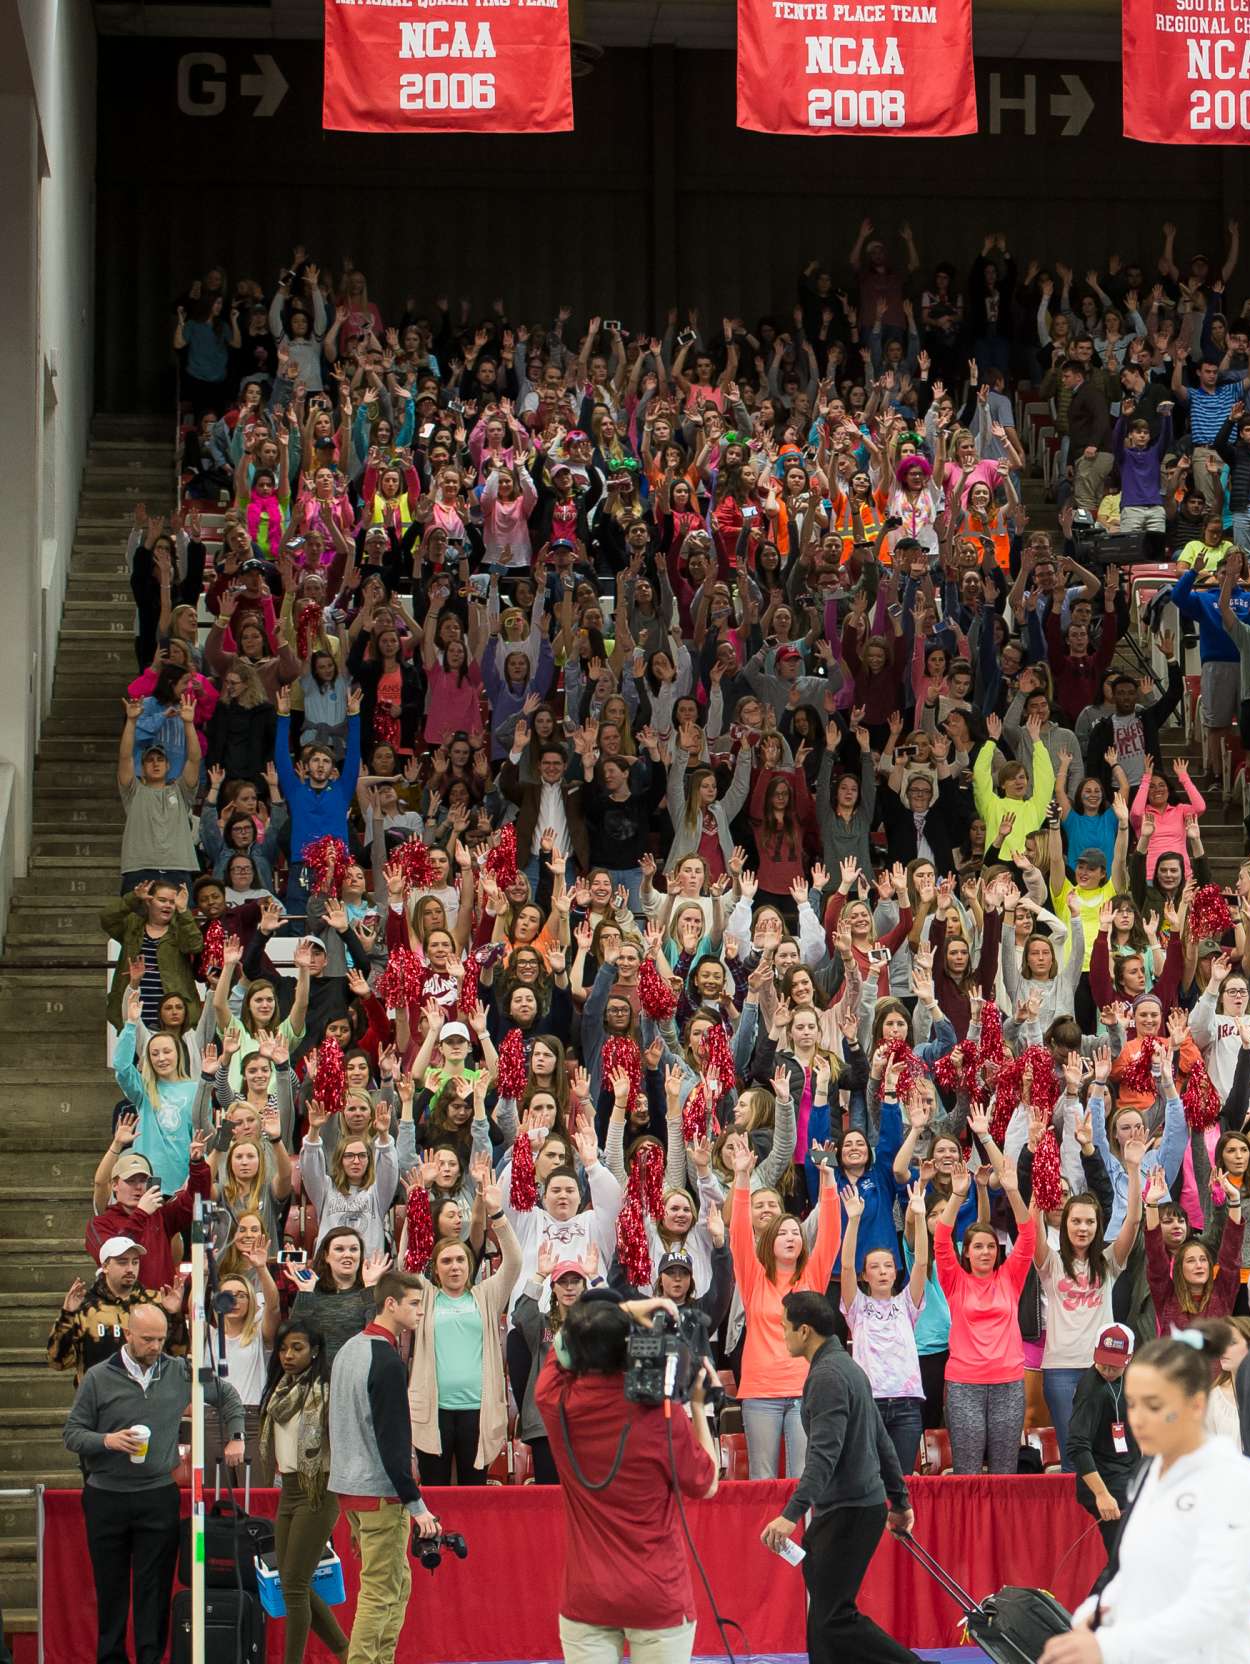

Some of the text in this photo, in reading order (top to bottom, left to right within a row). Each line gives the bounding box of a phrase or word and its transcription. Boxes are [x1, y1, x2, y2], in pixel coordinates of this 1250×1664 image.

[772, 1, 938, 24] TENTH PLACE TEAM
[1176, 0, 1225, 12] SOUTH
[1155, 13, 1231, 35] REGIONAL
[398, 21, 496, 59] NCAA
[804, 36, 905, 76] NCAA
[177, 52, 227, 116] G
[399, 72, 496, 110] 2006
[807, 88, 906, 128] 2008
[989, 72, 1037, 136] H
[112, 593, 128, 603] 20
[110, 622, 125, 632] 19
[70, 880, 86, 892] 13
[45, 1002, 64, 1013] 10
